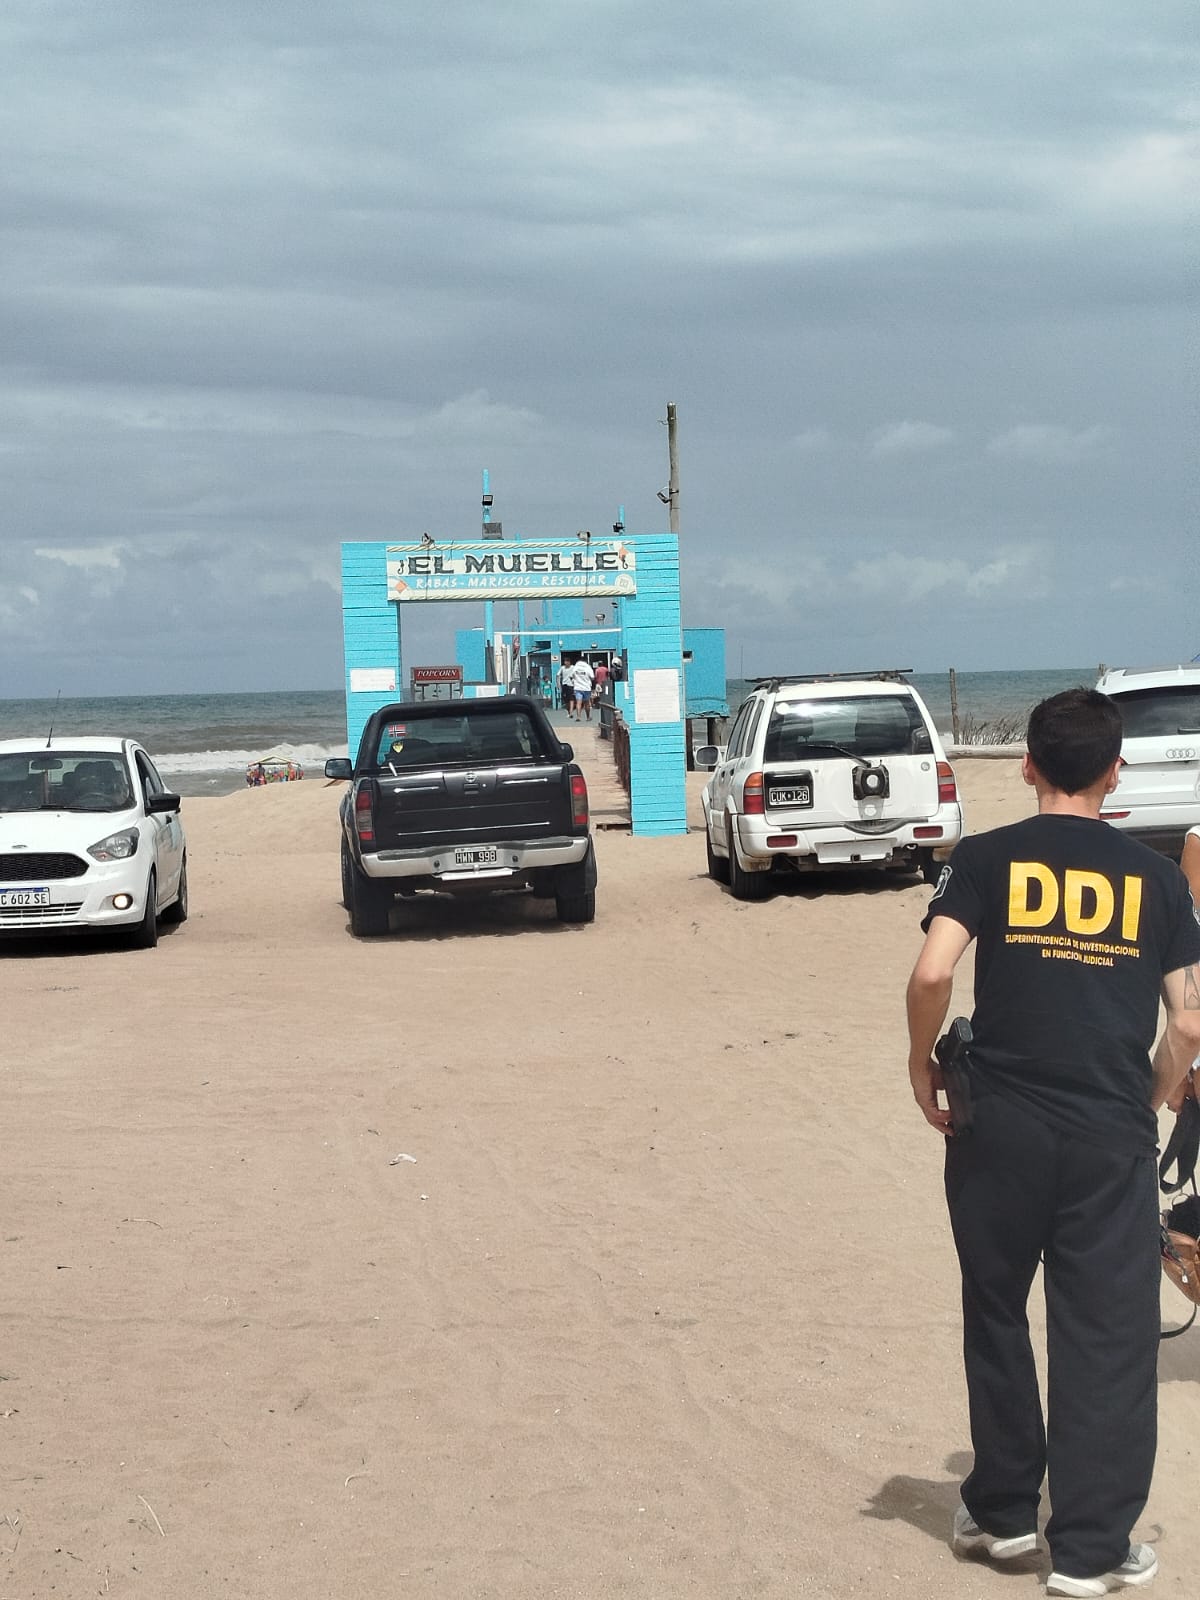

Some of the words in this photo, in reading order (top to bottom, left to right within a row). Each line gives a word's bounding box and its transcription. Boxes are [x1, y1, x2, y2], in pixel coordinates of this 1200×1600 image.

[408, 555, 454, 575] EL
[465, 552, 618, 574] MUELLE
[416, 577, 457, 589] RABAS
[468, 576, 530, 588] MARISCOS
[542, 575, 606, 586] RESTOBAR
[417, 669, 457, 677] POPCORN
[771, 791, 787, 802] CUK
[792, 790, 808, 801] 126
[479, 851, 496, 862] 998
[11, 894, 30, 905] 602
[34, 893, 47, 904] SE
[1008, 861, 1143, 942] DDI
[1005, 934, 1072, 946] SUPERINTENDENCIA
[1079, 941, 1140, 958] INVESTIGACIONES
[1041, 948, 1052, 958] EN
[1082, 955, 1114, 967] JUDICIAL
